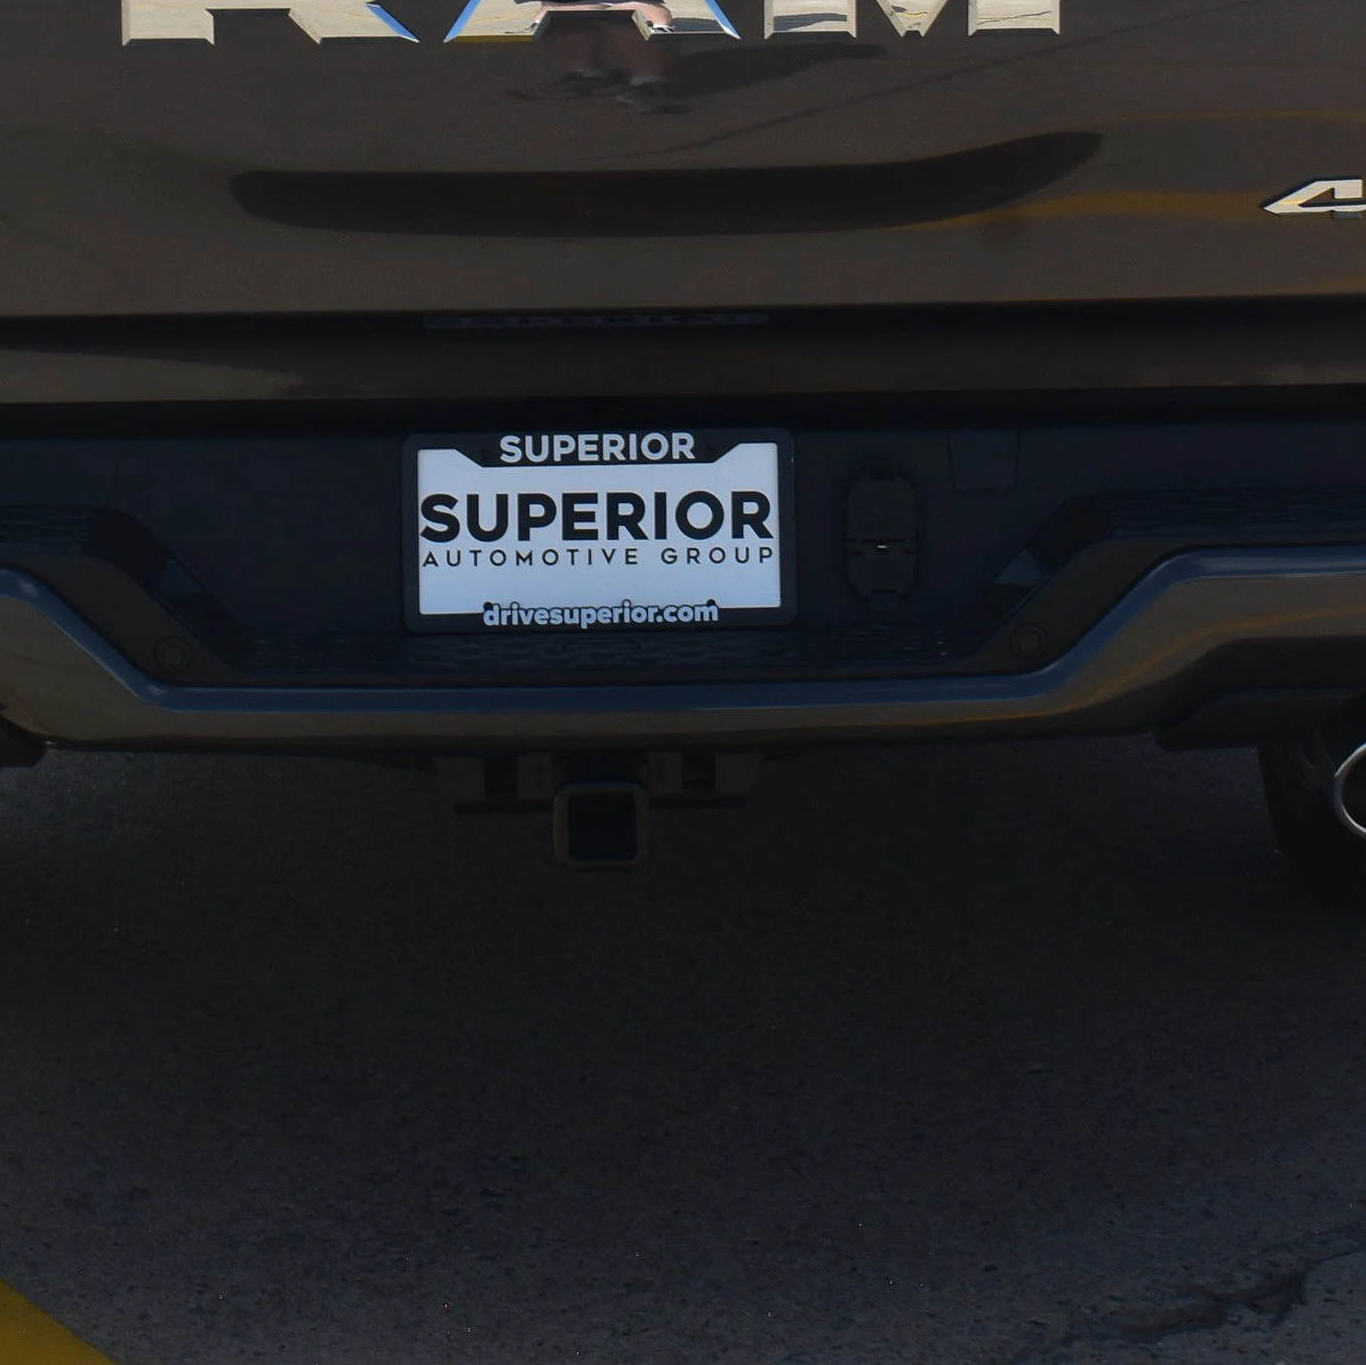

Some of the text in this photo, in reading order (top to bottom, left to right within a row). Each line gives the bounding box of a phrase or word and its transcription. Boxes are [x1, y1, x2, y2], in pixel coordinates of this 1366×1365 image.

[499, 432, 695, 463] SUPERIOR
[420, 490, 775, 543] SUPERIOR
[422, 546, 773, 568] AUTOMOTIVE GROUP
[483, 600, 719, 629] drivesuperior.com
